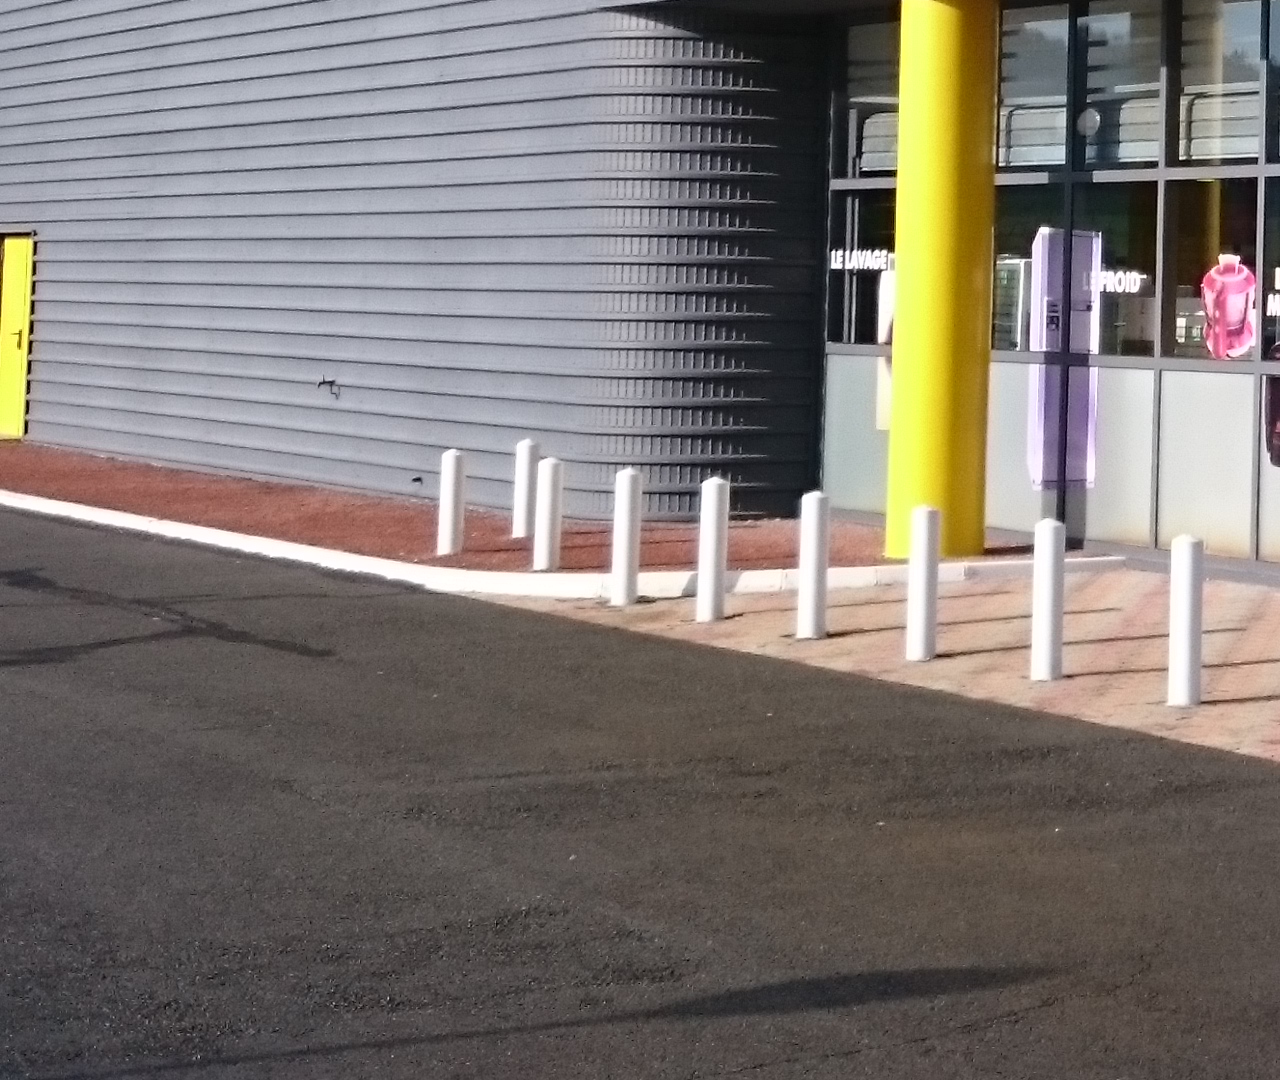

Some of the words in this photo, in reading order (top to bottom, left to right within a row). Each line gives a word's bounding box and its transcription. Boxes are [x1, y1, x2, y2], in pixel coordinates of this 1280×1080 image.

[830, 251, 844, 270] LE
[845, 249, 889, 270] LAVAGE
[1099, 270, 1142, 293] FROID
